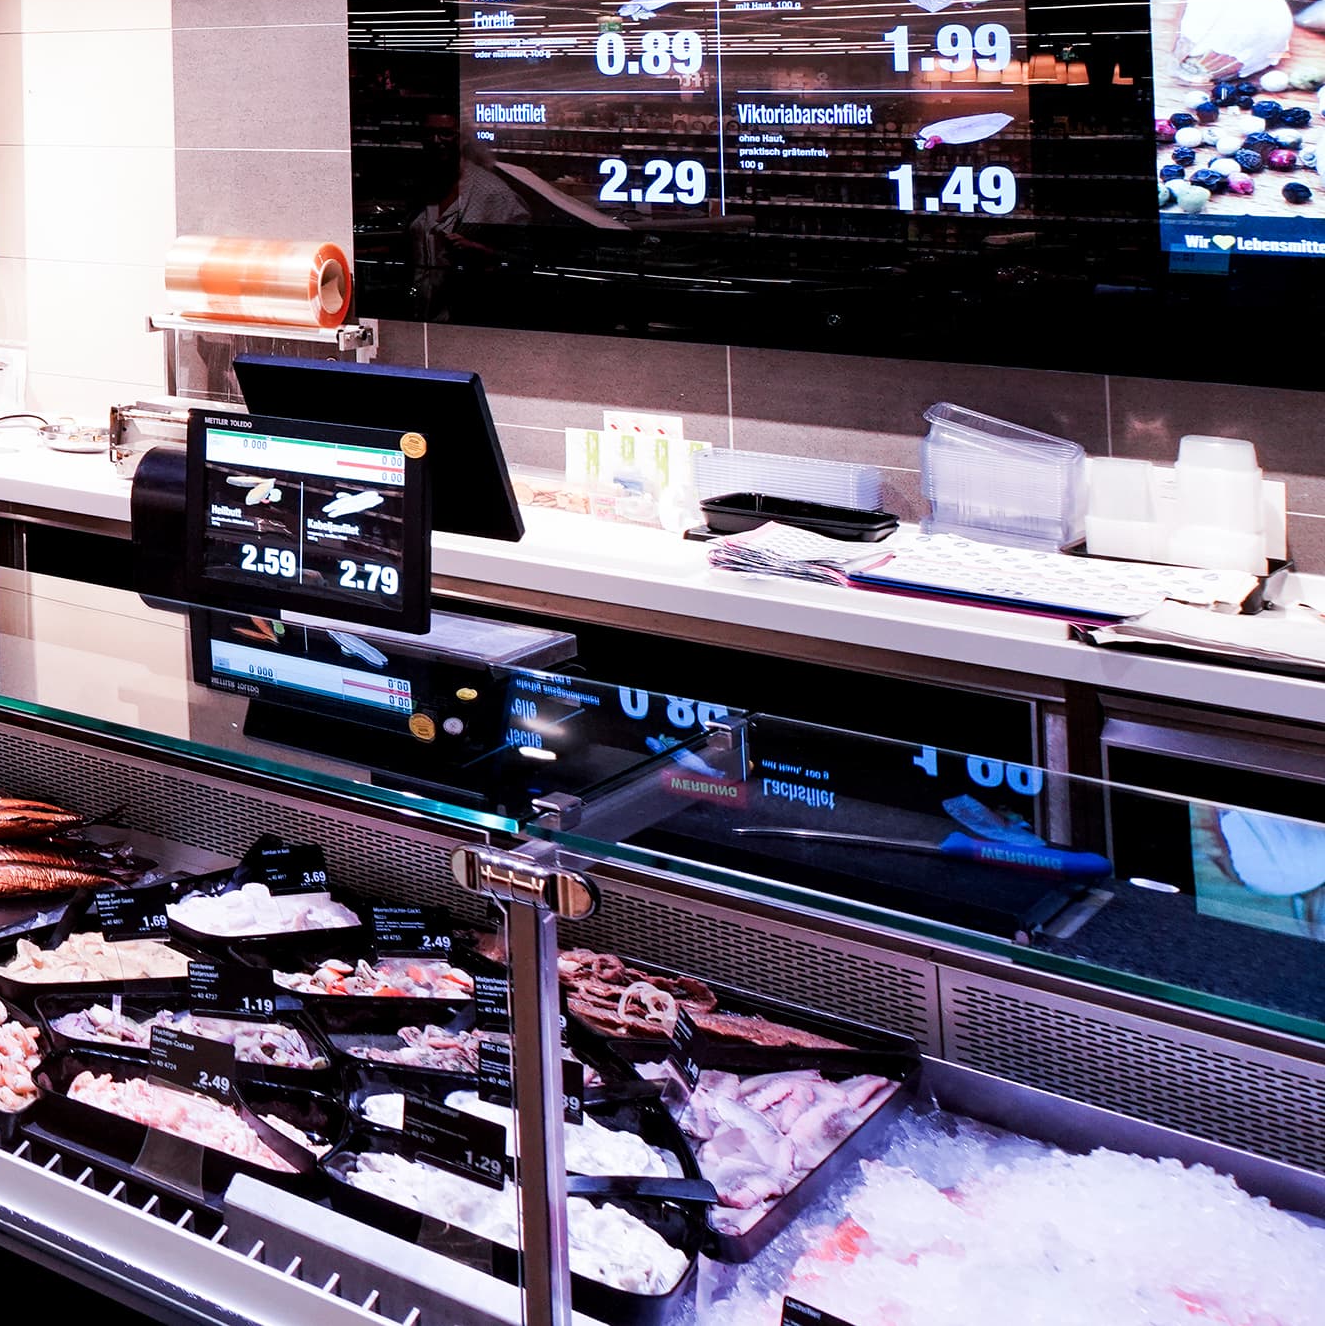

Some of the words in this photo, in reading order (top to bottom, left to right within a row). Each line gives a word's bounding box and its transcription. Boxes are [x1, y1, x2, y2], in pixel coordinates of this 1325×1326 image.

[474, 11, 515, 29] Forelle
[595, 30, 703, 75] 0.89
[884, 24, 1012, 73] 1.99
[475, 103, 547, 123] Heilbuttfilet
[738, 103, 873, 125] Viktoriabarschfilet
[476, 130, 495, 141] 100g
[739, 134, 760, 143] ohne
[761, 134, 786, 145] Haut,
[739, 147, 781, 158] praktisch
[782, 147, 829, 159] grätenfrei,
[739, 160, 756, 169] 100
[757, 162, 764, 171] g
[599, 158, 707, 205] 2.29
[888, 164, 1017, 215] 1.49
[1184, 234, 1211, 249] Wir
[204, 416, 229, 426] METTLER
[230, 419, 253, 429] TOLEDO
[381, 455, 403, 467] 0.00
[381, 471, 403, 483] 0.00
[211, 504, 242, 518] Heilbutt
[307, 518, 360, 536] Kabeljaufilet
[241, 543, 296, 577] 2.59
[339, 559, 399, 595] 2.79
[303, 871, 326, 883] 3.69
[142, 915, 168, 927] 1.69
[422, 935, 451, 948] 2.49
[242, 996, 274, 1012] 1.19
[199, 1071, 230, 1091] 2.49
[464, 1150, 502, 1175] 1.29
